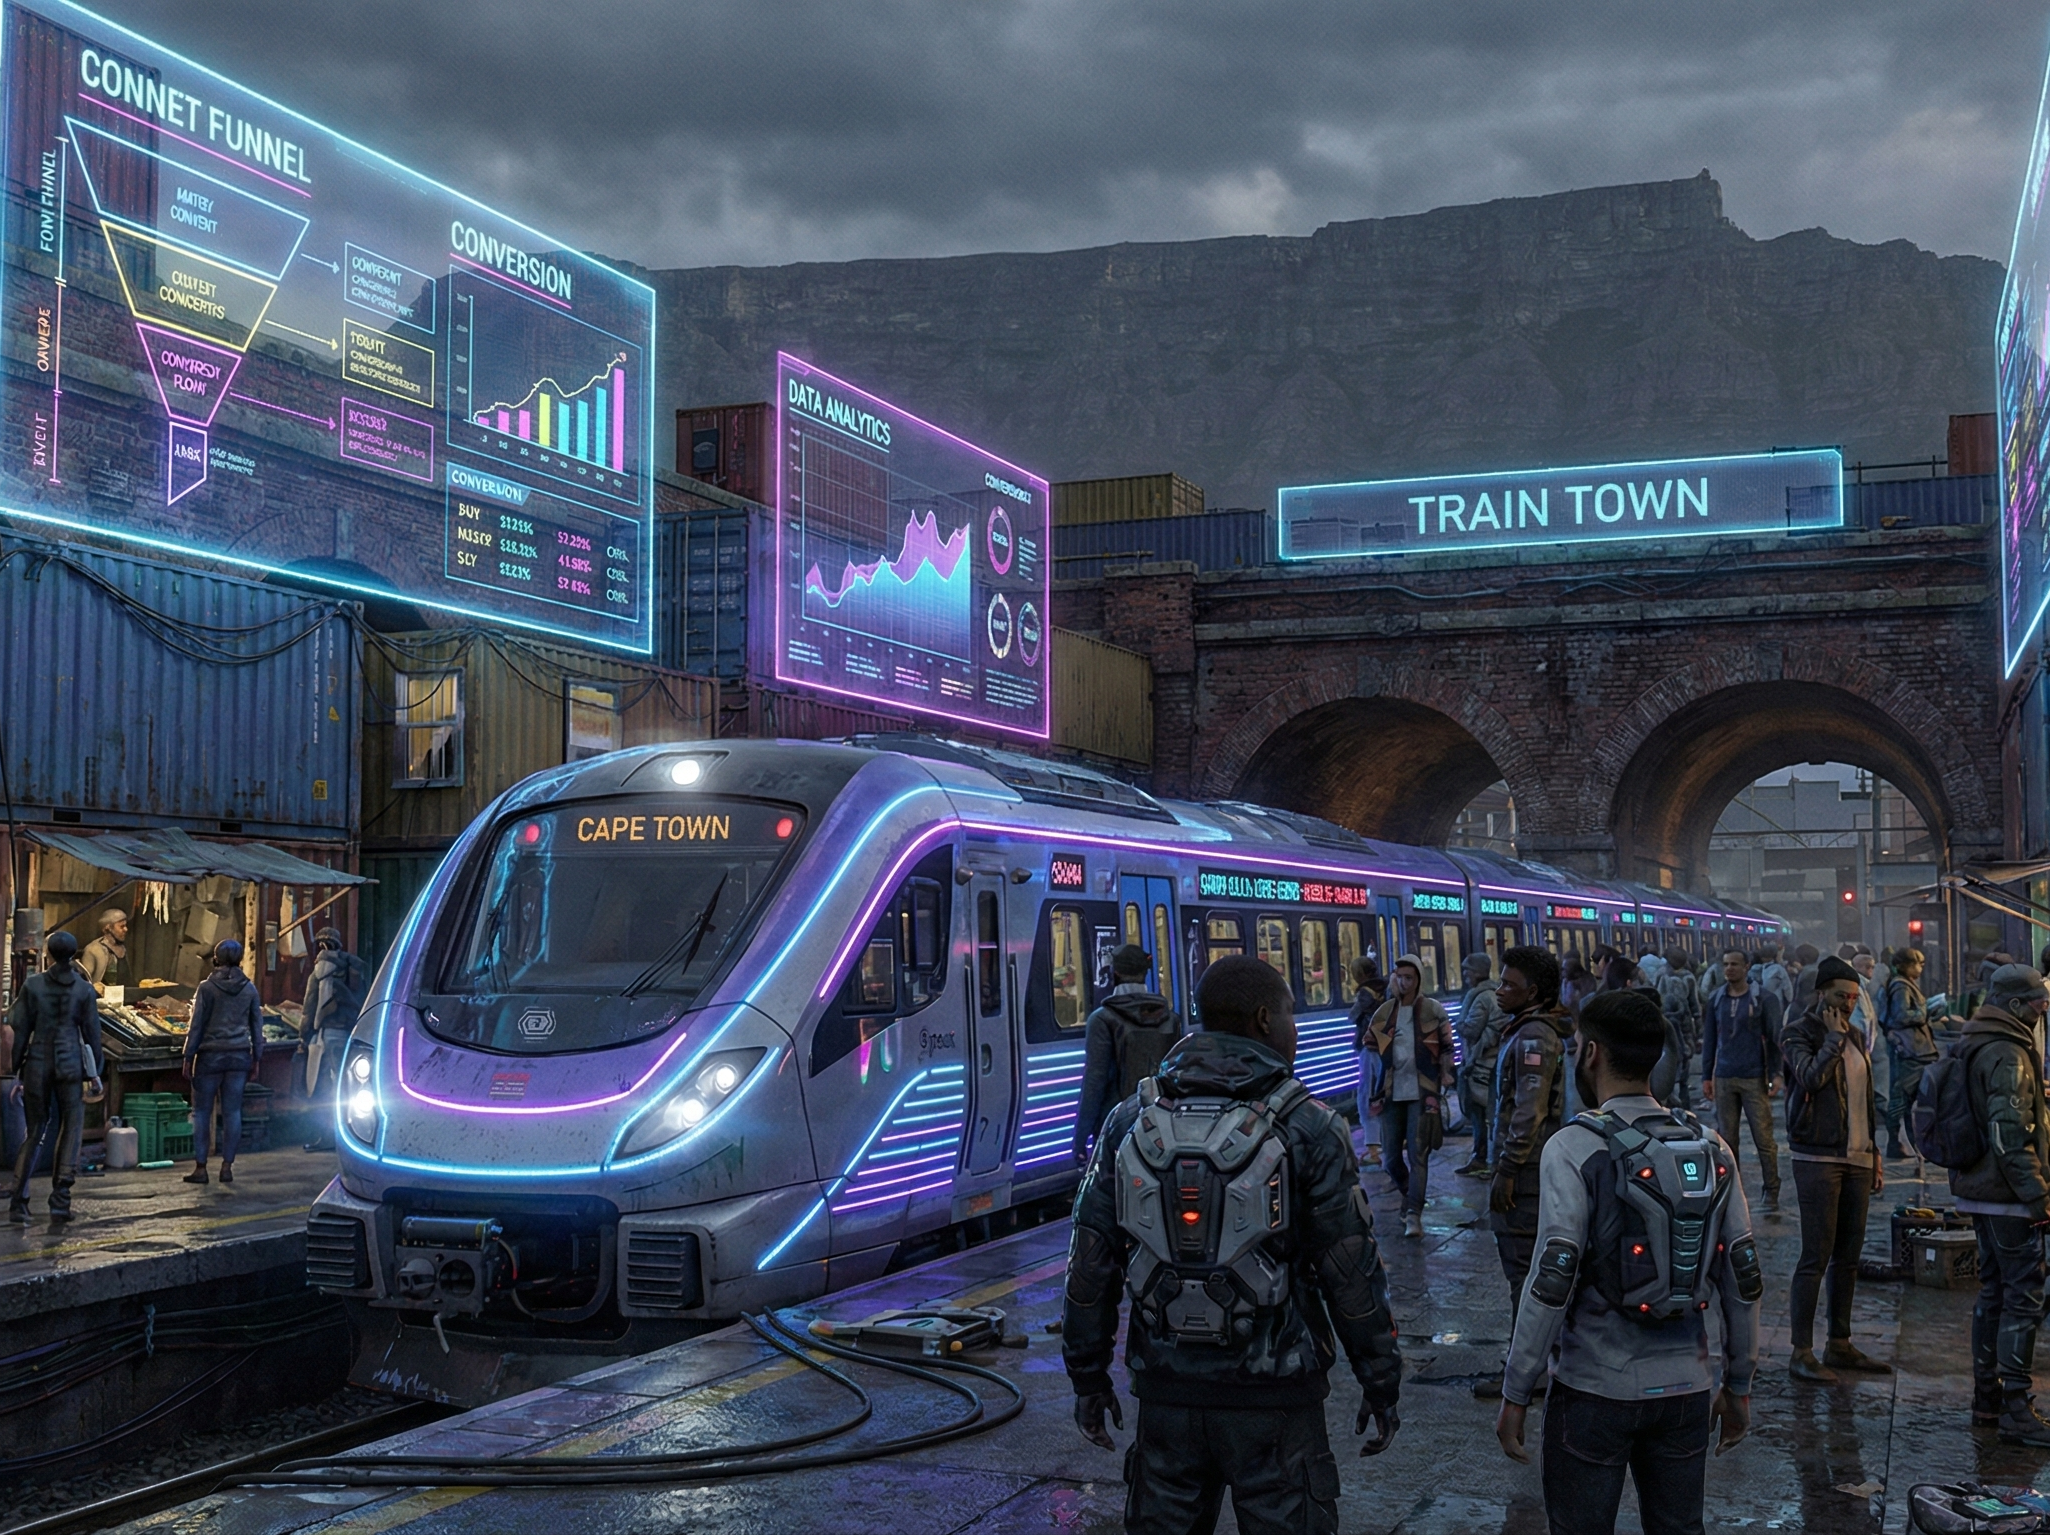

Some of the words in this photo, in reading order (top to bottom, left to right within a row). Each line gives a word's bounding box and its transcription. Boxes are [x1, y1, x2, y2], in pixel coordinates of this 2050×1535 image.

[81, 49, 201, 132] CONNET
[208, 106, 312, 184] FUNNEL
[451, 221, 572, 300] CONVERSION
[789, 378, 822, 417] DATA
[825, 396, 891, 446] ANALYTICS
[458, 502, 480, 520] BUY
[1407, 488, 1549, 535] TRAIN
[1565, 477, 1709, 525] TOWN
[578, 816, 645, 842] CAPE
[653, 815, 730, 841] TOWN
